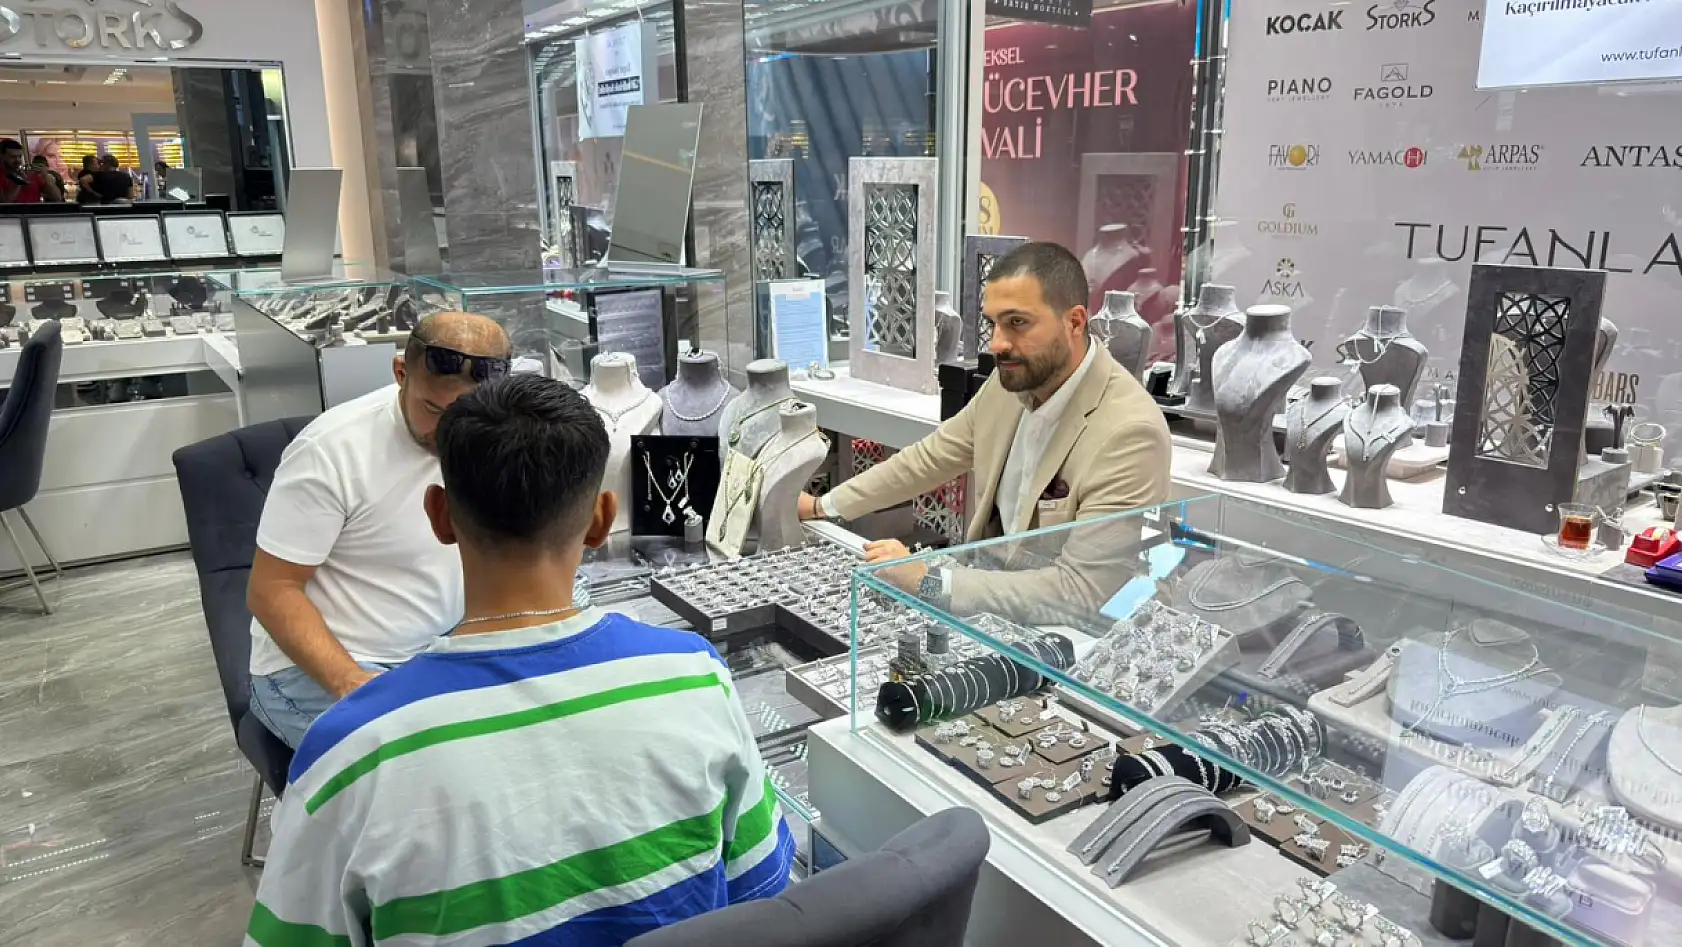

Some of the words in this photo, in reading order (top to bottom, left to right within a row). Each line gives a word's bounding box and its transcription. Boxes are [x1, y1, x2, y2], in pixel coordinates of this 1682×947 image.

[1366, 0, 1436, 30] STORKS
[984, 68, 1139, 114] ÜCEVHER
[1268, 77, 1332, 95] PIANO
[1354, 85, 1433, 100] FAGOLD
[1348, 147, 1428, 168] YAMACHI
[1258, 221, 1318, 236] GOLDIUM
